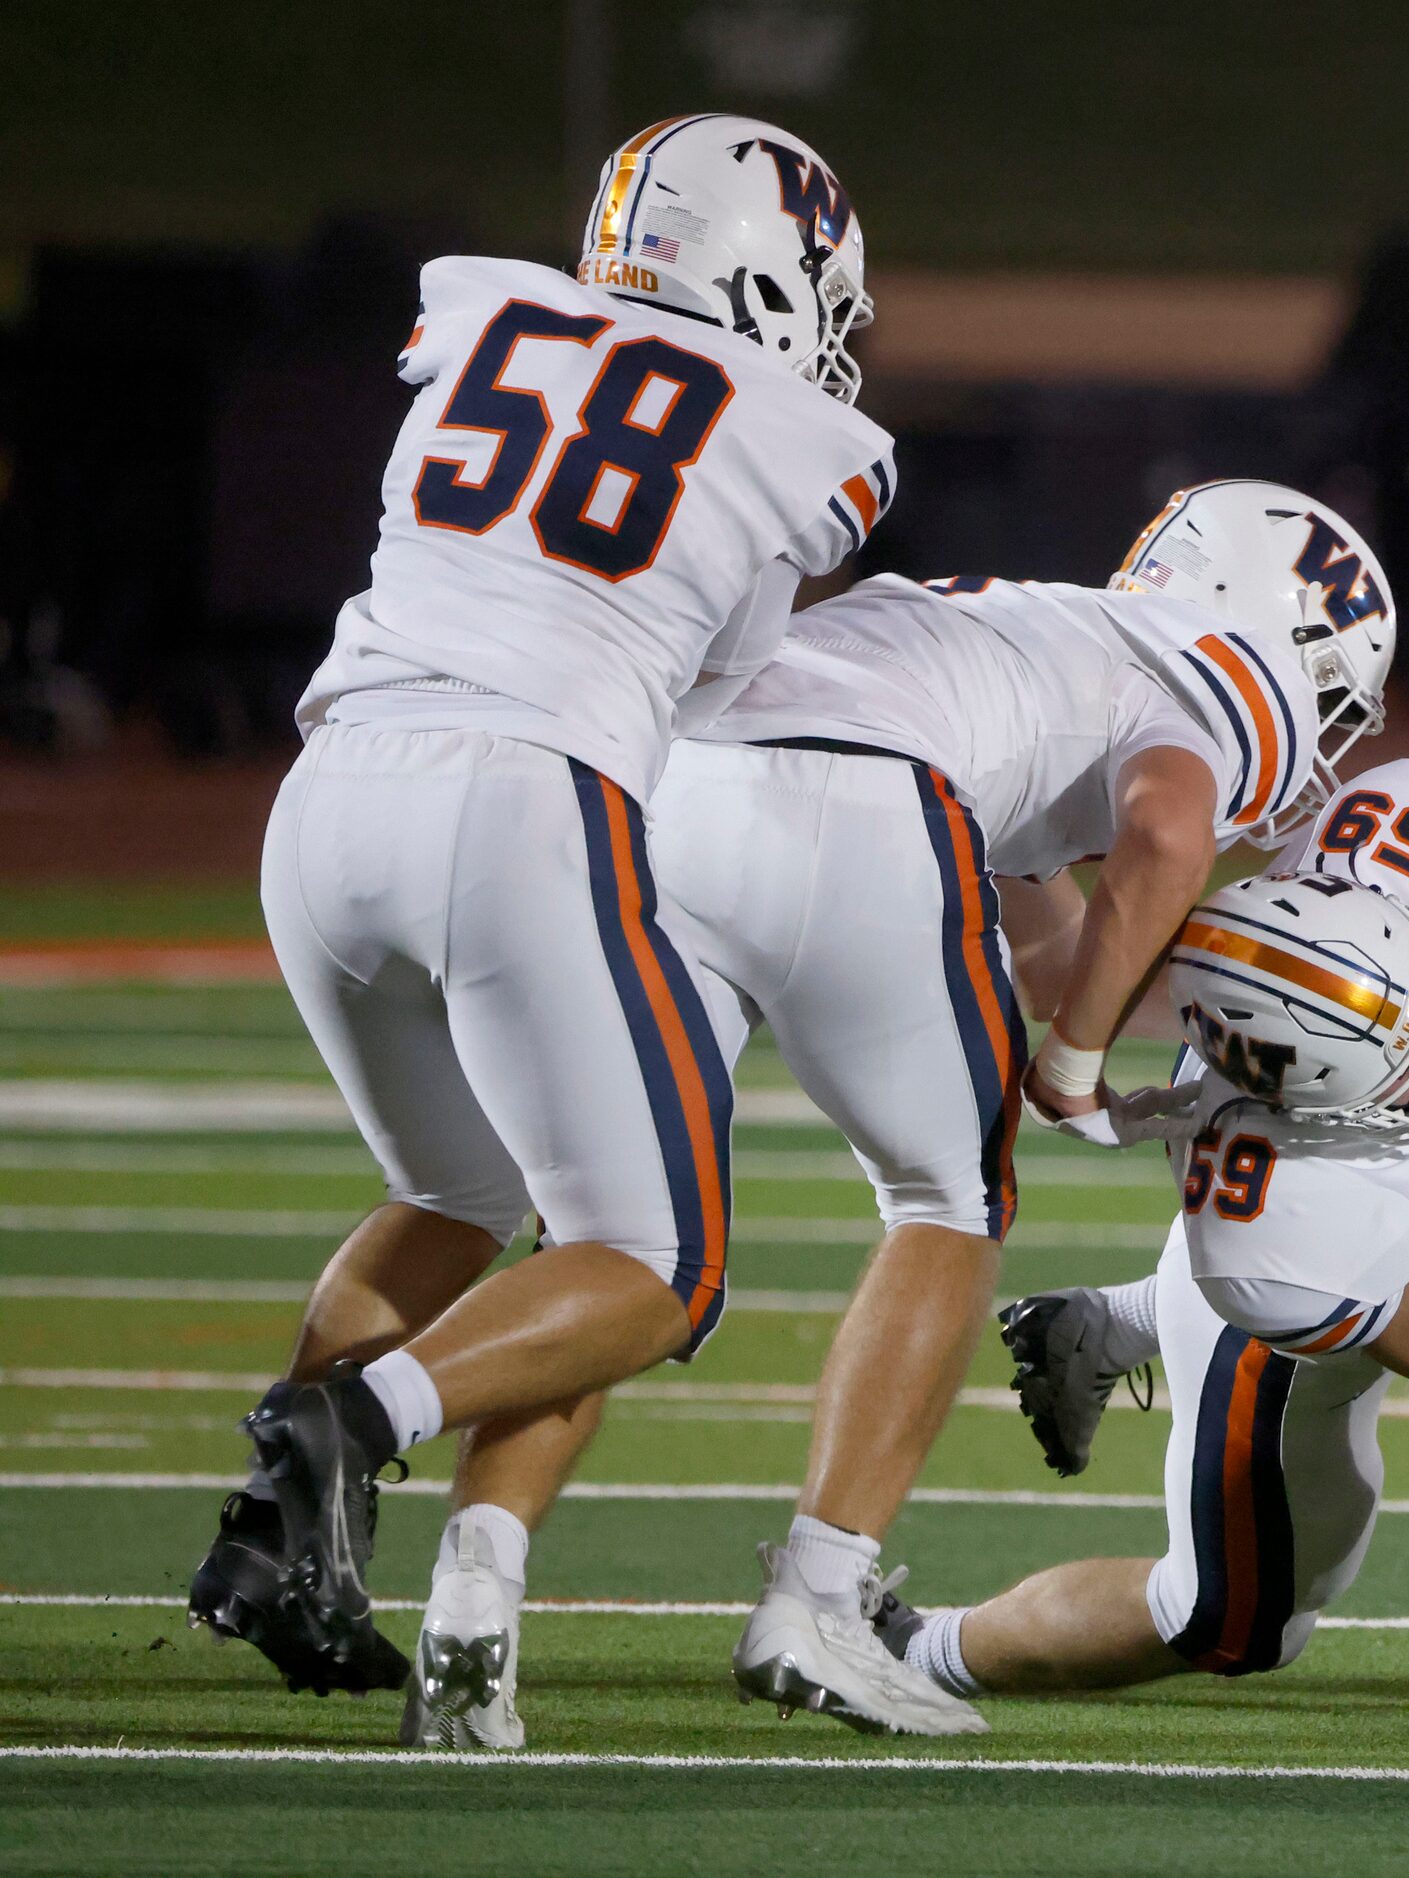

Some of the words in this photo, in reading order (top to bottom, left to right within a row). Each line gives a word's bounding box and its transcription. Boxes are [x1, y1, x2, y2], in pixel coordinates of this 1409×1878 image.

[758, 138, 856, 250] W
[595, 259, 659, 292] LAND
[411, 297, 736, 584] 58
[1291, 511, 1388, 633] W
[1184, 1128, 1278, 1224] 59
